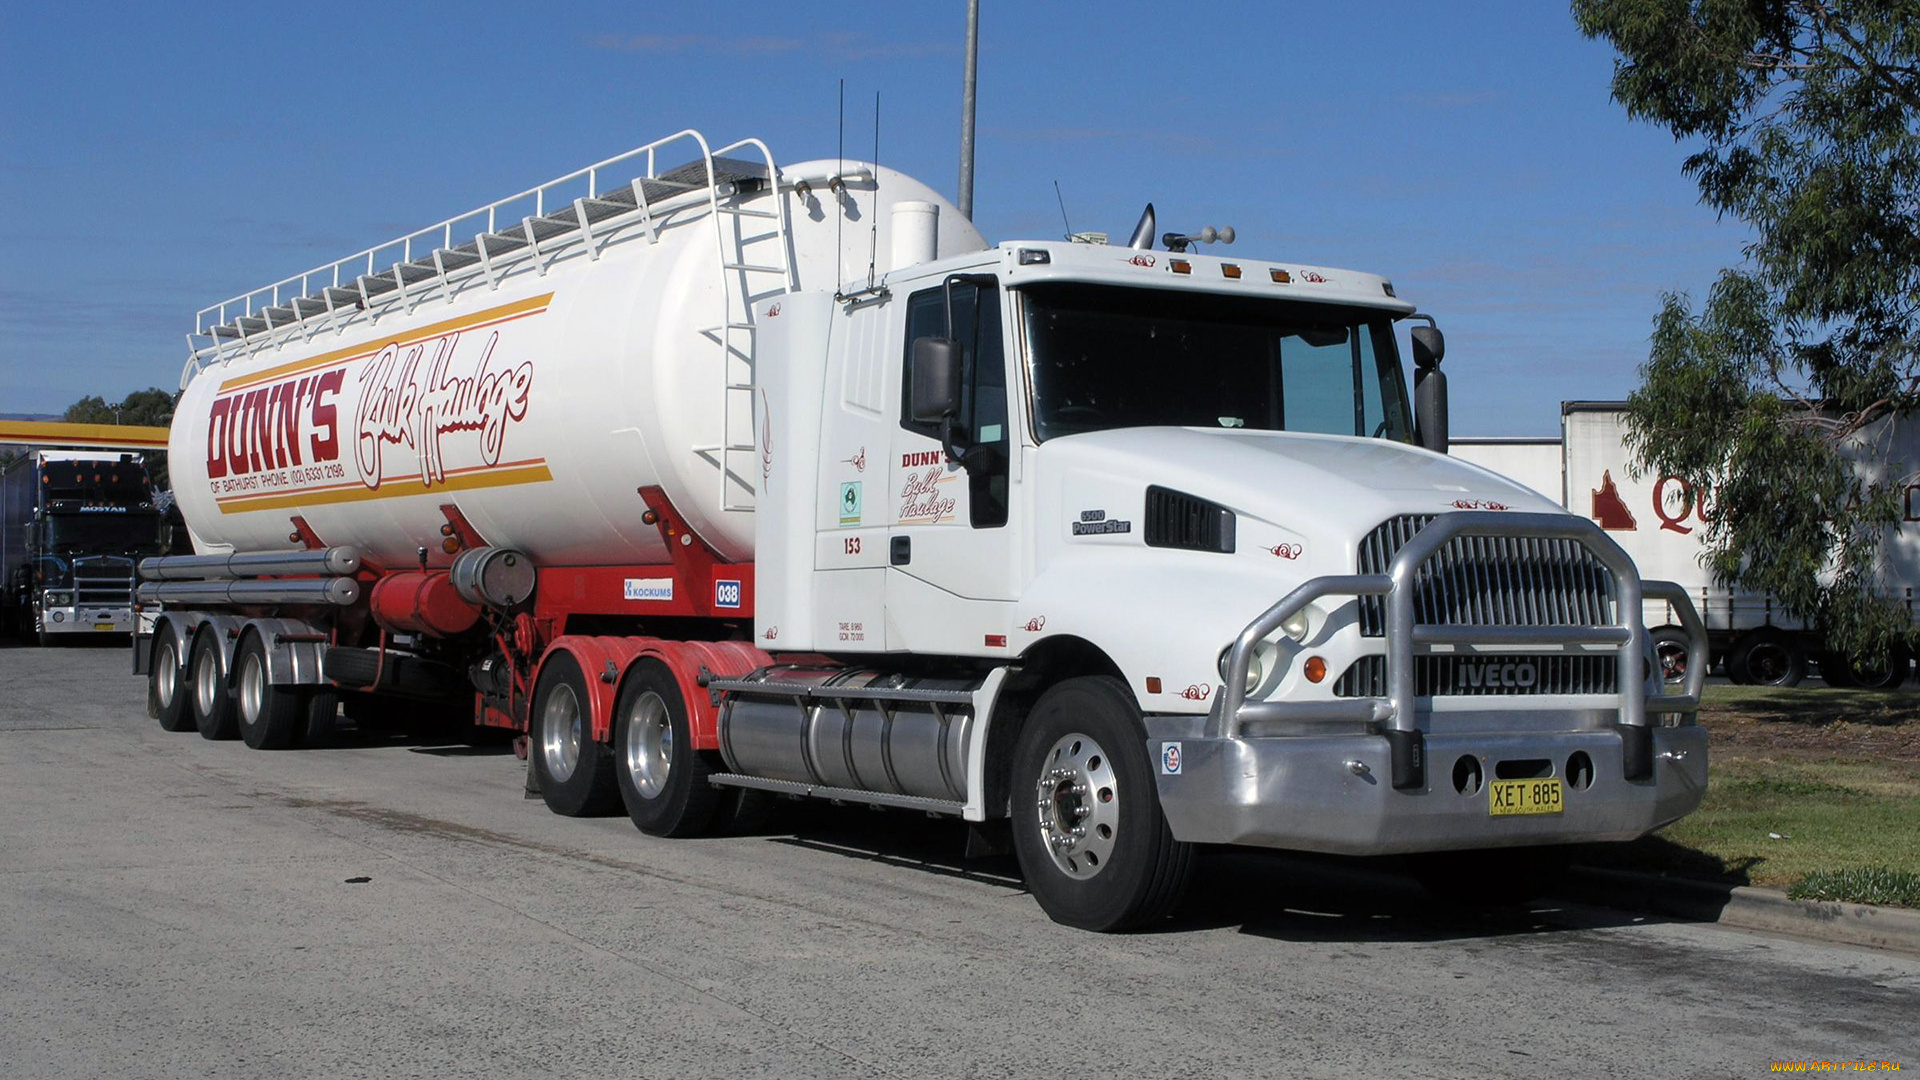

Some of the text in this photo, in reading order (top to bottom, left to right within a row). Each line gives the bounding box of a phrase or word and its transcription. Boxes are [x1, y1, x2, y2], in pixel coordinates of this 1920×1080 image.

[206, 368, 347, 479] DUNN'S
[902, 450, 952, 467] DUNN'
[210, 463, 345, 494] OF BATHURST PHONE (02) 6331 2198
[901, 466, 943, 498] Bulk
[899, 490, 956, 524] Haulage
[1072, 520, 1131, 535] PowerStar
[844, 537, 861, 555] 153
[633, 588, 671, 597] KOCKUMS
[718, 585, 738, 603] 038
[1458, 664, 1536, 687] IVECO
